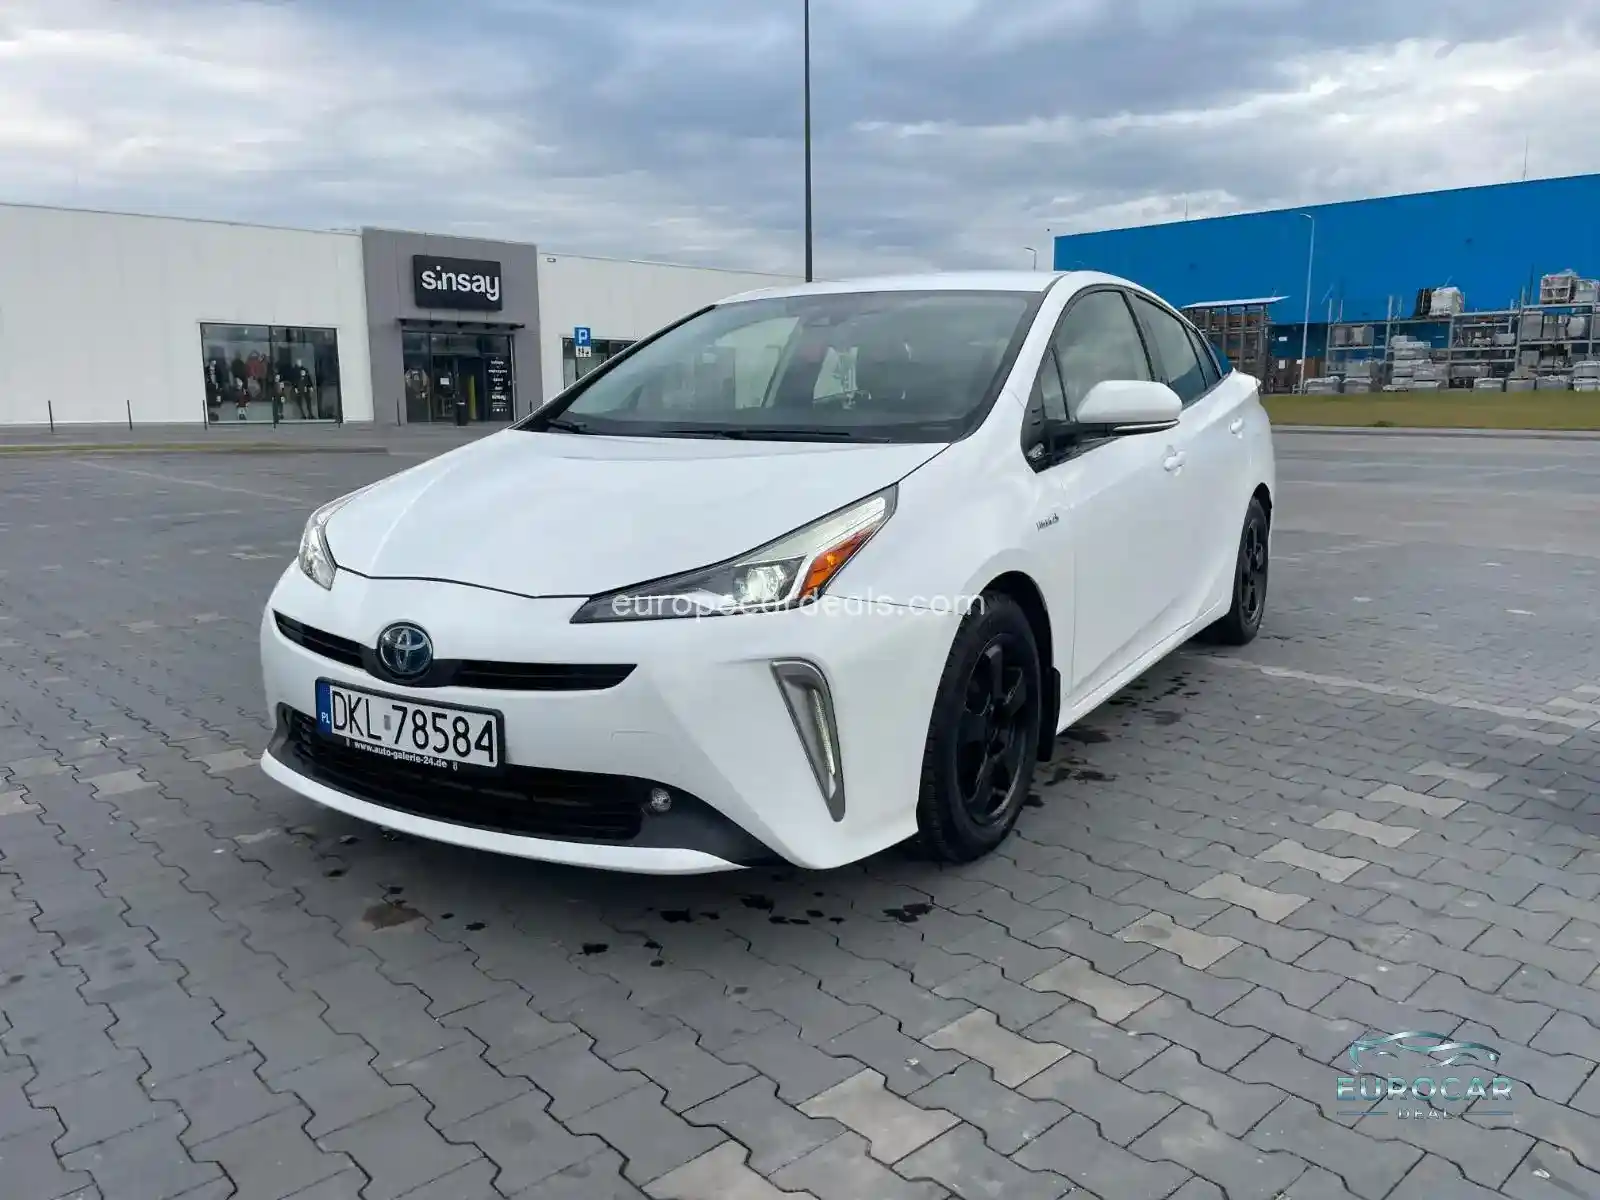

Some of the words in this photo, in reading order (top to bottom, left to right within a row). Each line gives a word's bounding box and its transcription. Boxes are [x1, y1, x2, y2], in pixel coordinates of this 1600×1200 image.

[421, 265, 500, 301] sinsay
[578, 329, 588, 344] P
[321, 711, 331, 724] PL
[332, 690, 382, 741] DKL
[391, 704, 494, 763] 78584
[354, 741, 448, 769] www.auto-galerie-24.de
